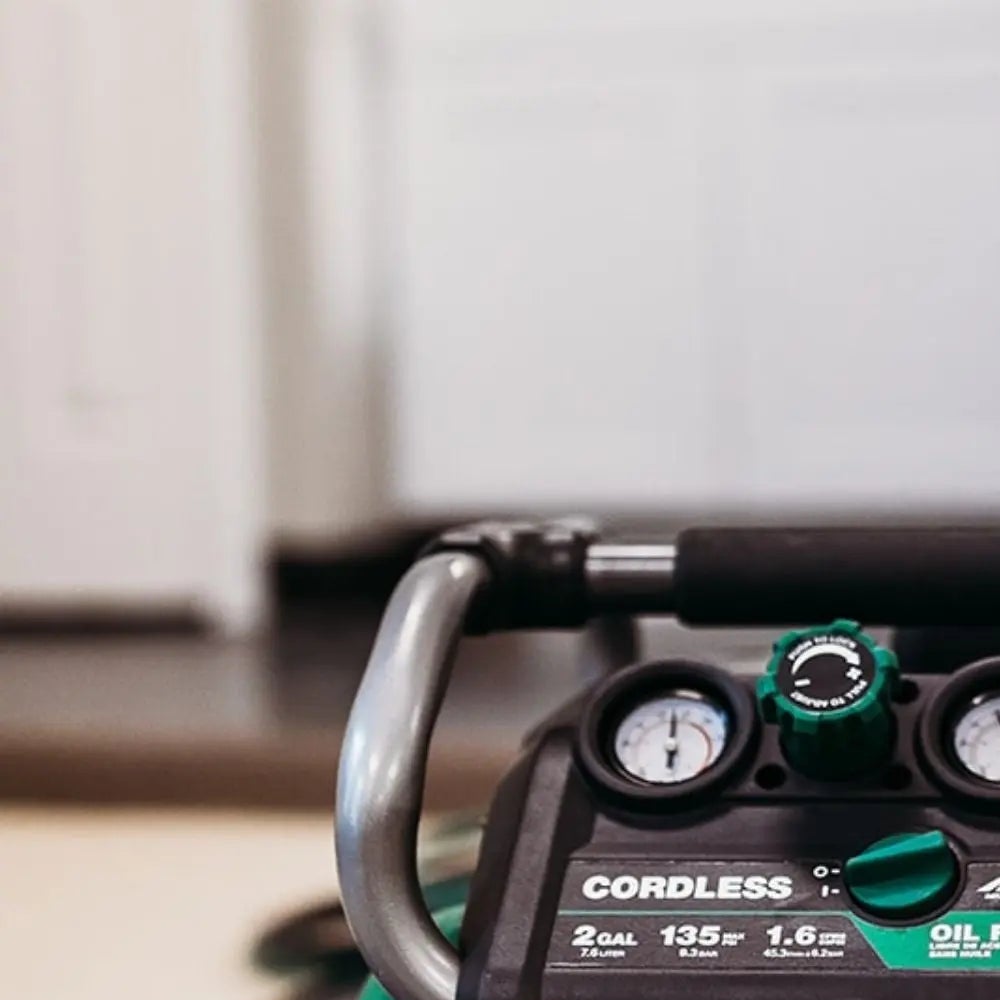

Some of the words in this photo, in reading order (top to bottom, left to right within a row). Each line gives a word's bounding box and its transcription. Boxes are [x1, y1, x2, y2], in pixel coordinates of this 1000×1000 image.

[582, 875, 793, 900] CORDLESS
[660, 924, 721, 946] 135
[766, 924, 818, 946] 1.6
[930, 924, 981, 942] OIL
